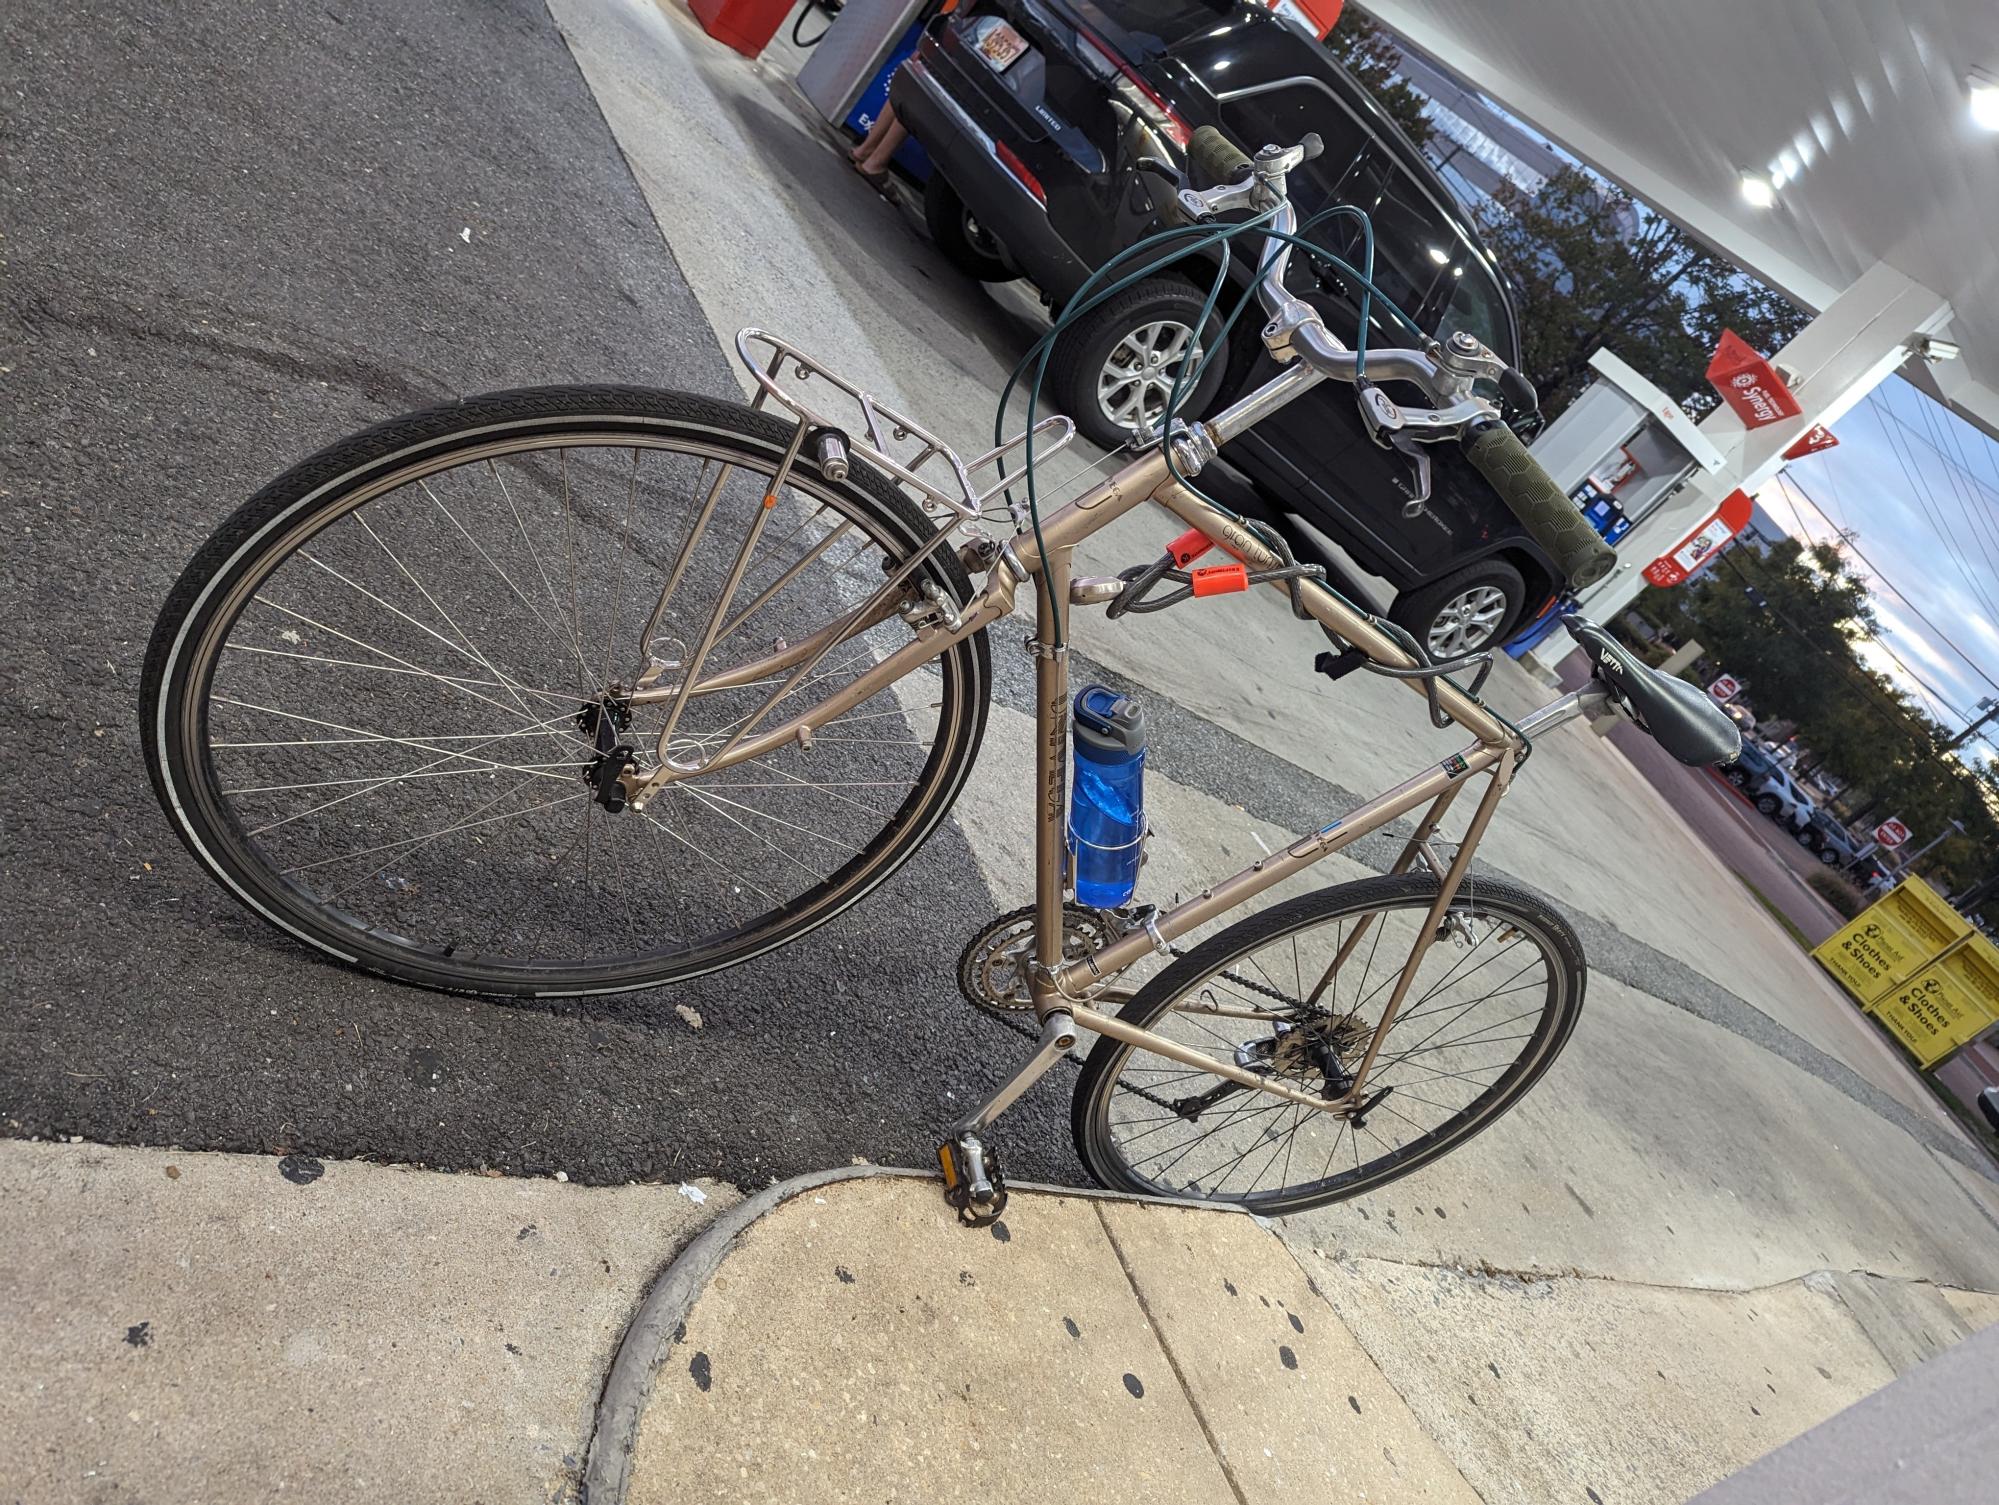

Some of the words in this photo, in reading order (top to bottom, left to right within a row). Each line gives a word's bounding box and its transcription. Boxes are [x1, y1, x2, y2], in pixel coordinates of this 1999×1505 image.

[1742, 386, 1777, 421] Synergy
[1842, 940, 1852, 951] &
[1851, 948, 1882, 979] Shoes
[1852, 933, 1891, 972] Clothes
[1899, 994, 1910, 1005] &
[1908, 1004, 1939, 1036] Shoes
[1910, 987, 1950, 1028] Clothes
